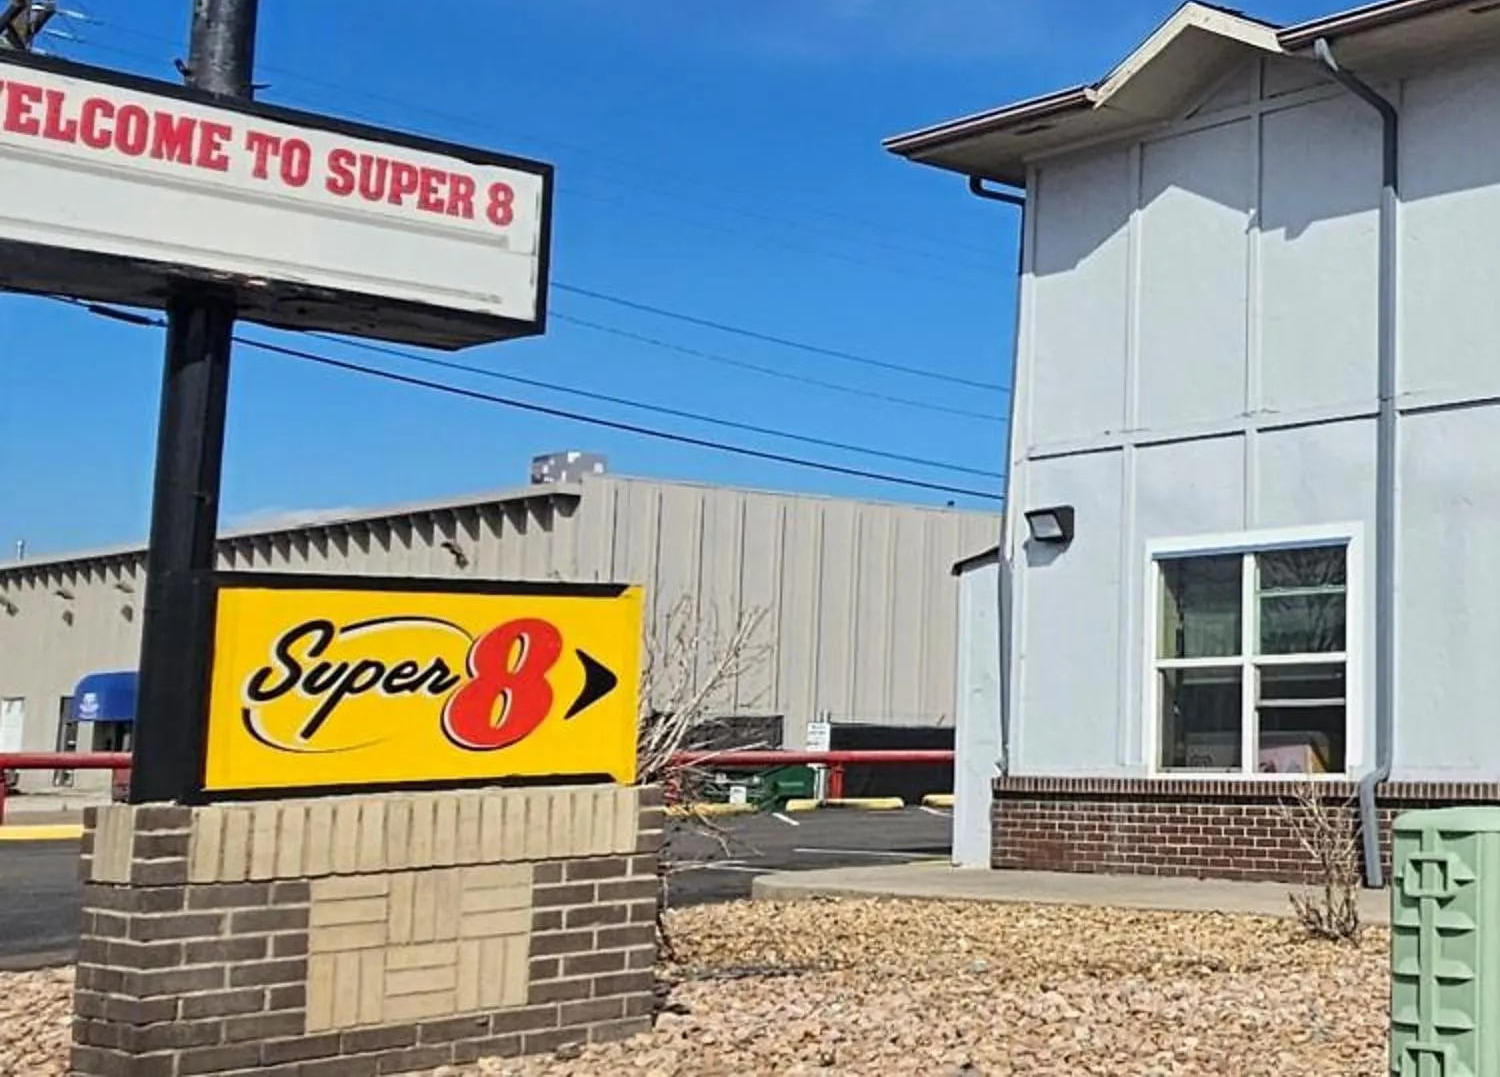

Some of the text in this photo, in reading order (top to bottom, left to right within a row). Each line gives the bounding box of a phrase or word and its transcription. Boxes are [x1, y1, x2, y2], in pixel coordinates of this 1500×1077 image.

[0, 80, 515, 226] ELCOME TO SUPER 8
[246, 617, 563, 751] Super 8
